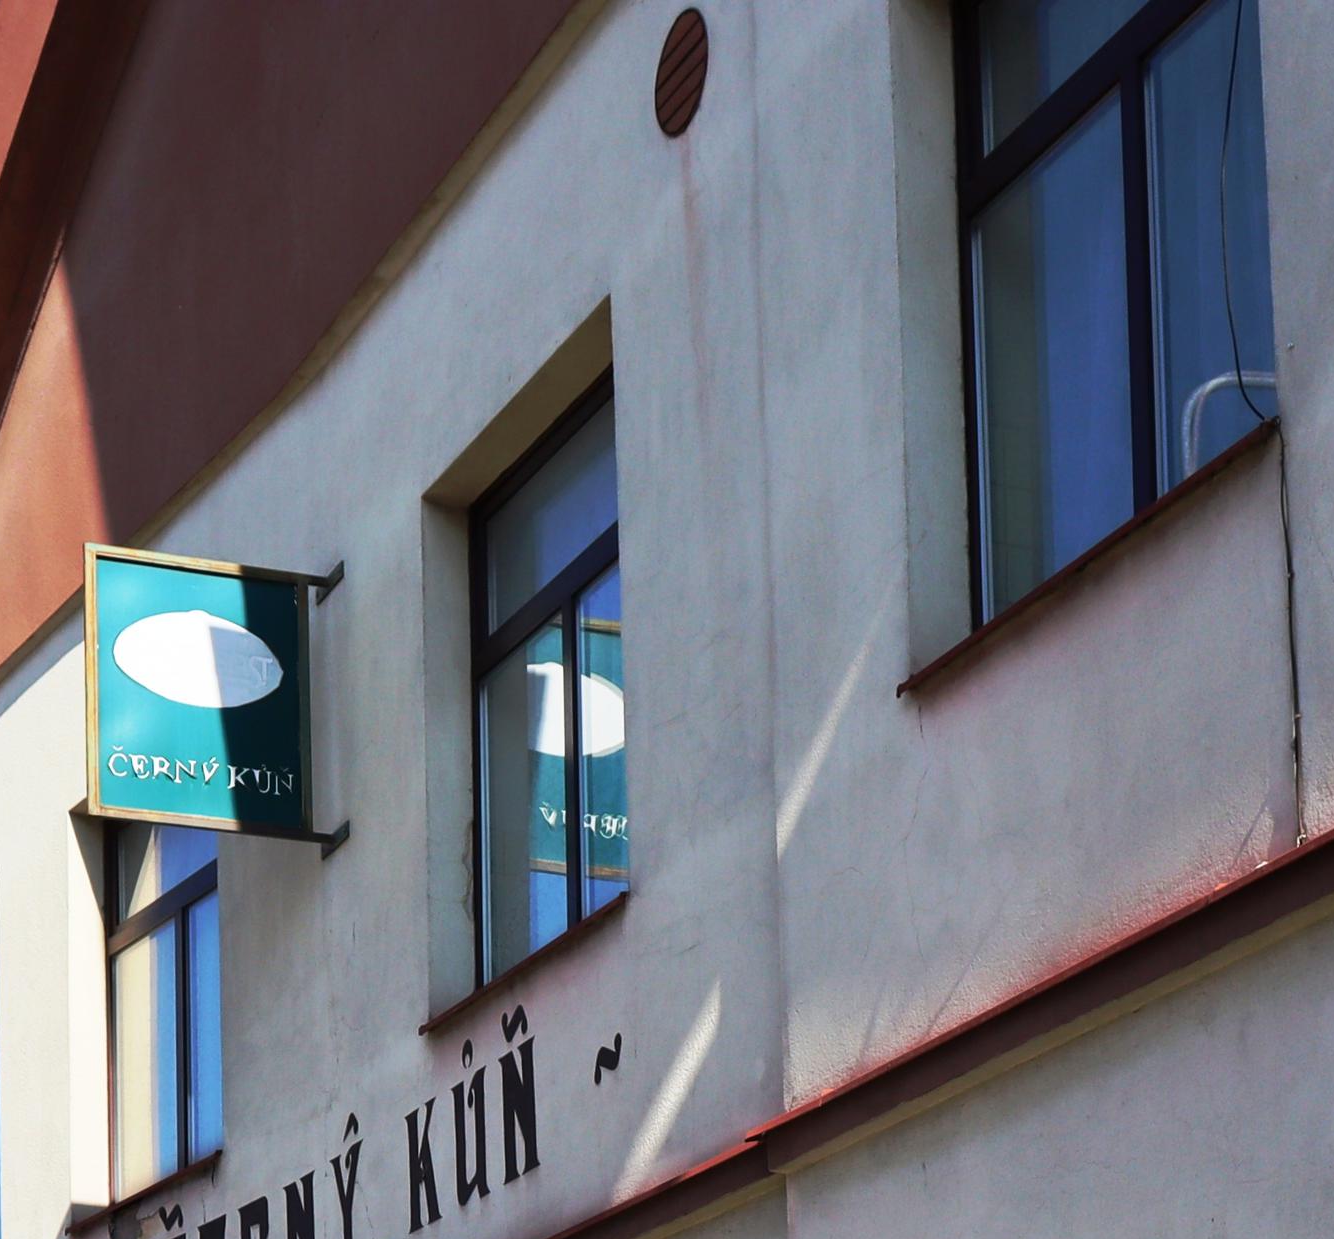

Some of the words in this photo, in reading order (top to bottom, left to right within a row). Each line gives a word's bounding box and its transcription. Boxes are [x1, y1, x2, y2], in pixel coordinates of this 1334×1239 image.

[108, 745, 219, 784] ČERNÝ
[227, 764, 294, 796] KŮŇ
[405, 1004, 540, 1234] KŮŇ
